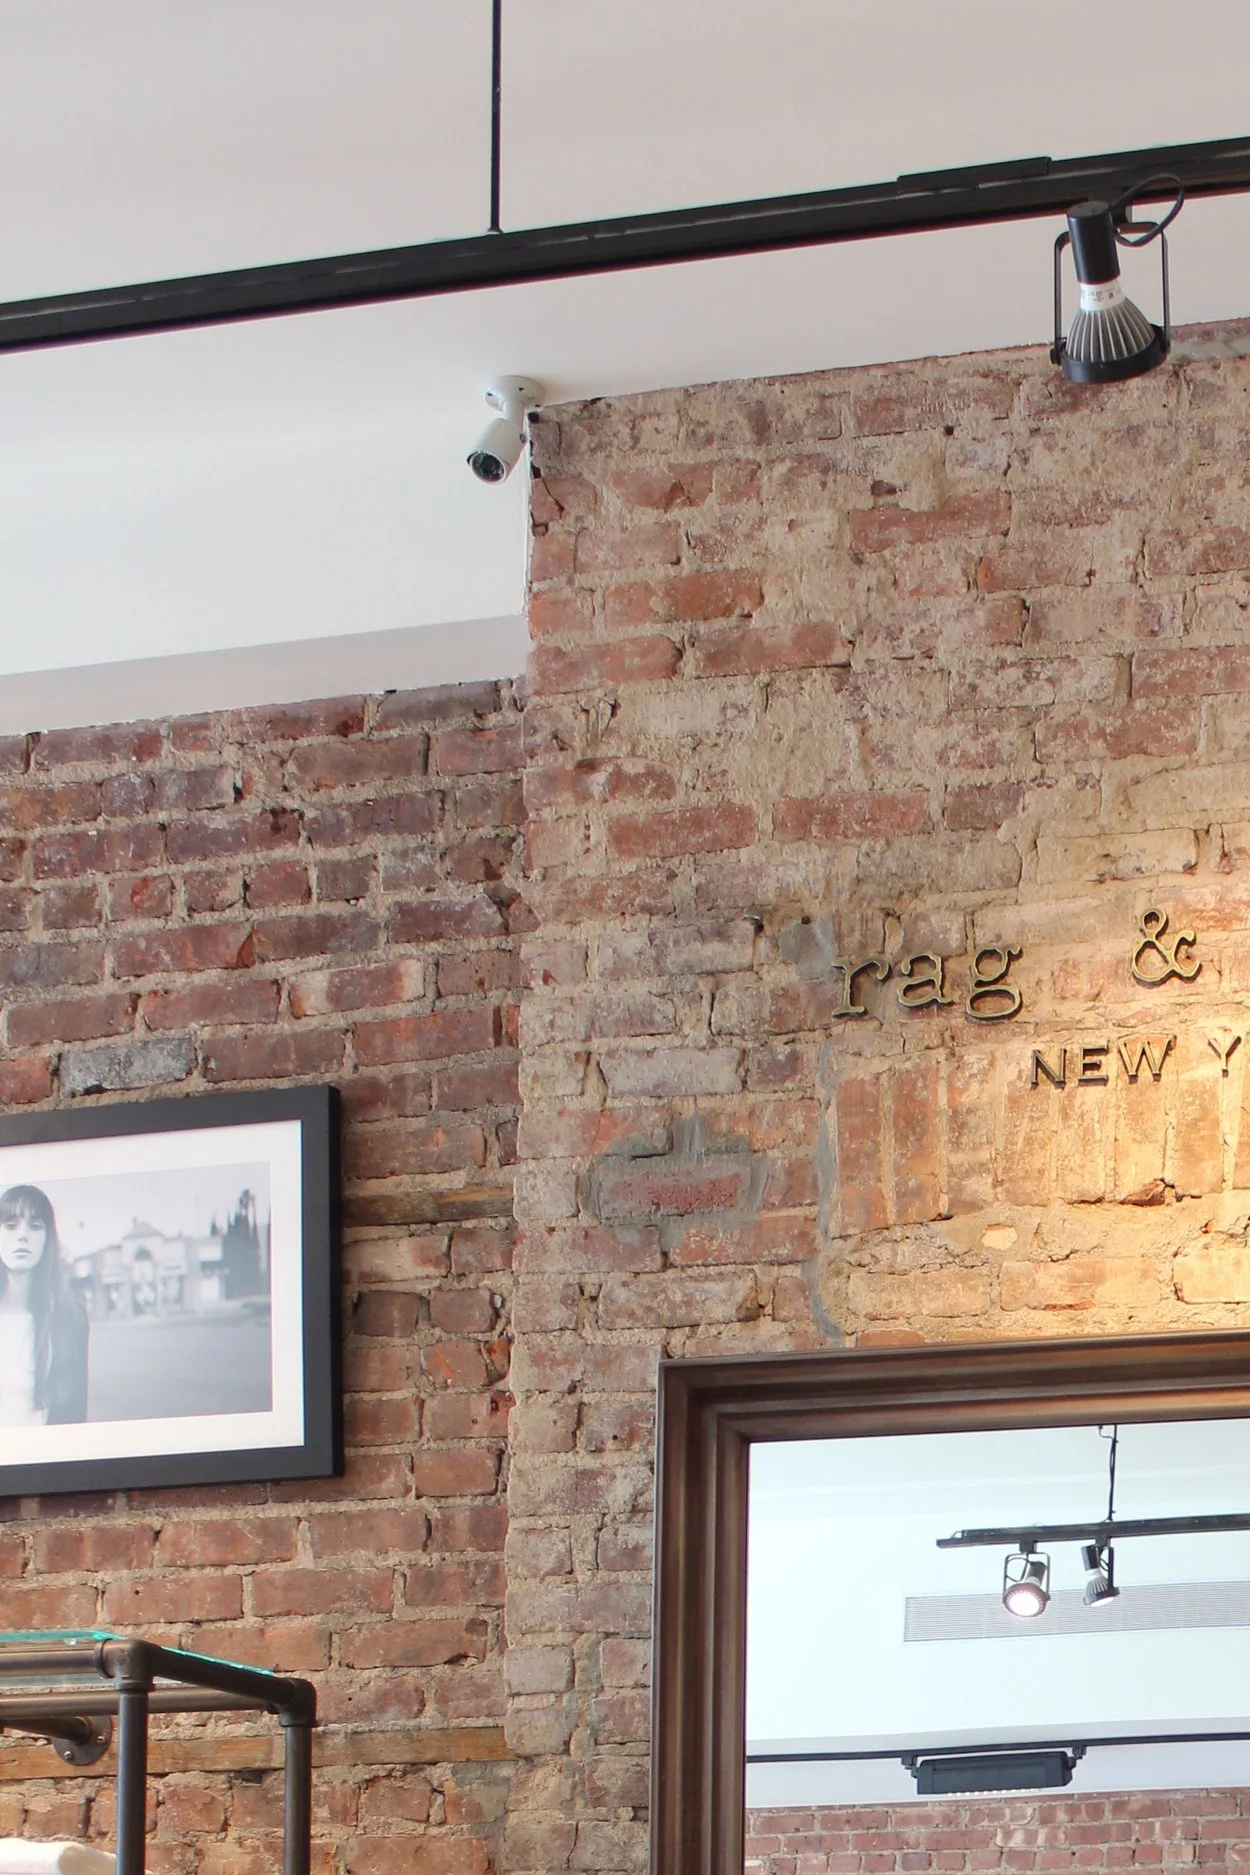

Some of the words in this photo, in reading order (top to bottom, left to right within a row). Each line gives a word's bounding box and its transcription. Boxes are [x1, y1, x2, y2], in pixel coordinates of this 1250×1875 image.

[833, 944, 1024, 1021] rag
[1131, 907, 1202, 986] &
[1030, 1036, 1175, 1088] NEW
